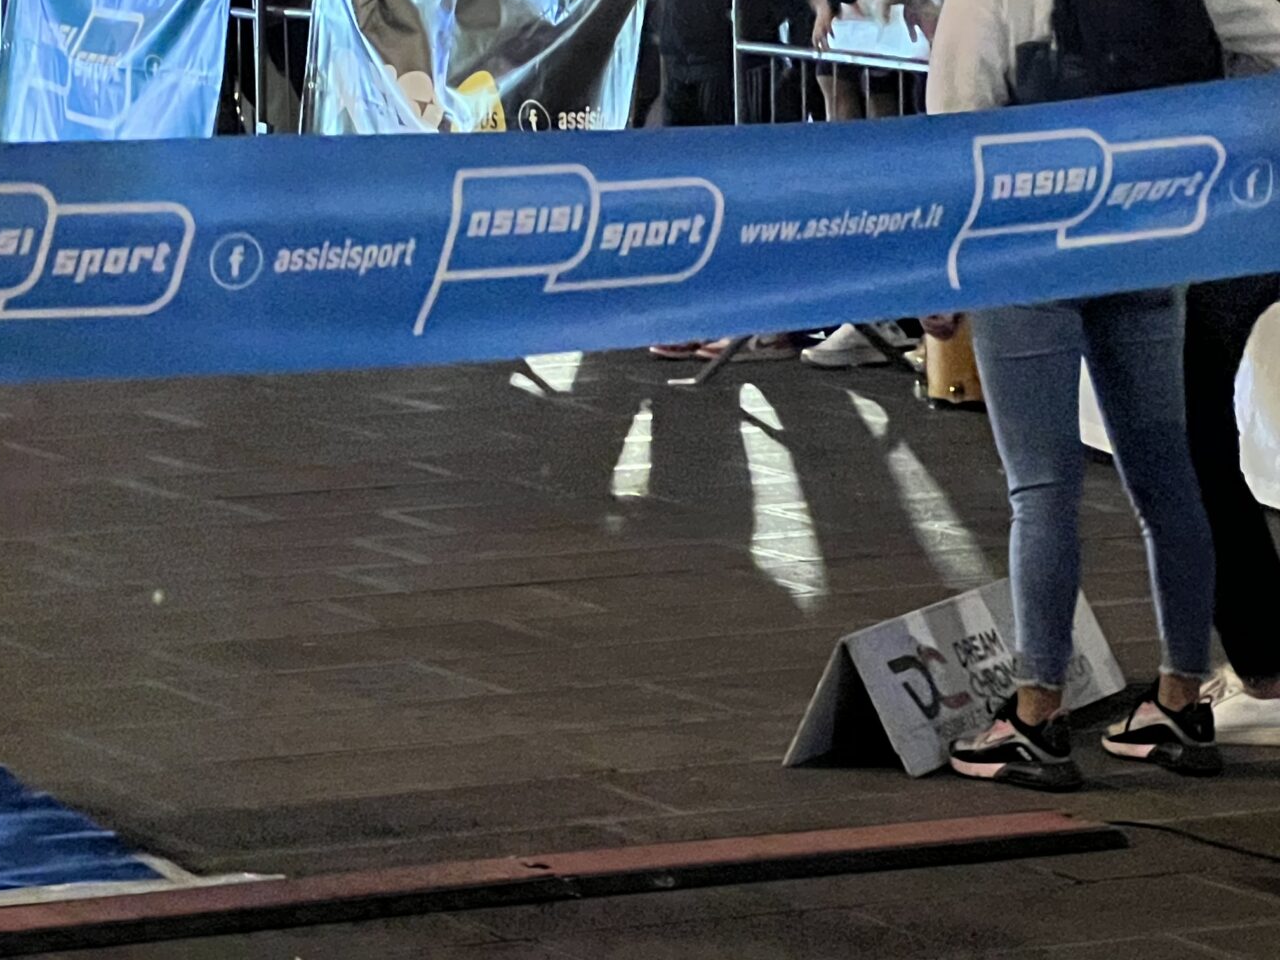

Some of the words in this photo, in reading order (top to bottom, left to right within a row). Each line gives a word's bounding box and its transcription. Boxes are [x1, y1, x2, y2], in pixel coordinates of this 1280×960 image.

[1107, 170, 1204, 211] sport
[599, 214, 706, 257] sport
[740, 203, 945, 244] www.assisisport.it
[51, 242, 172, 285] sport
[273, 237, 417, 276] assisisport
